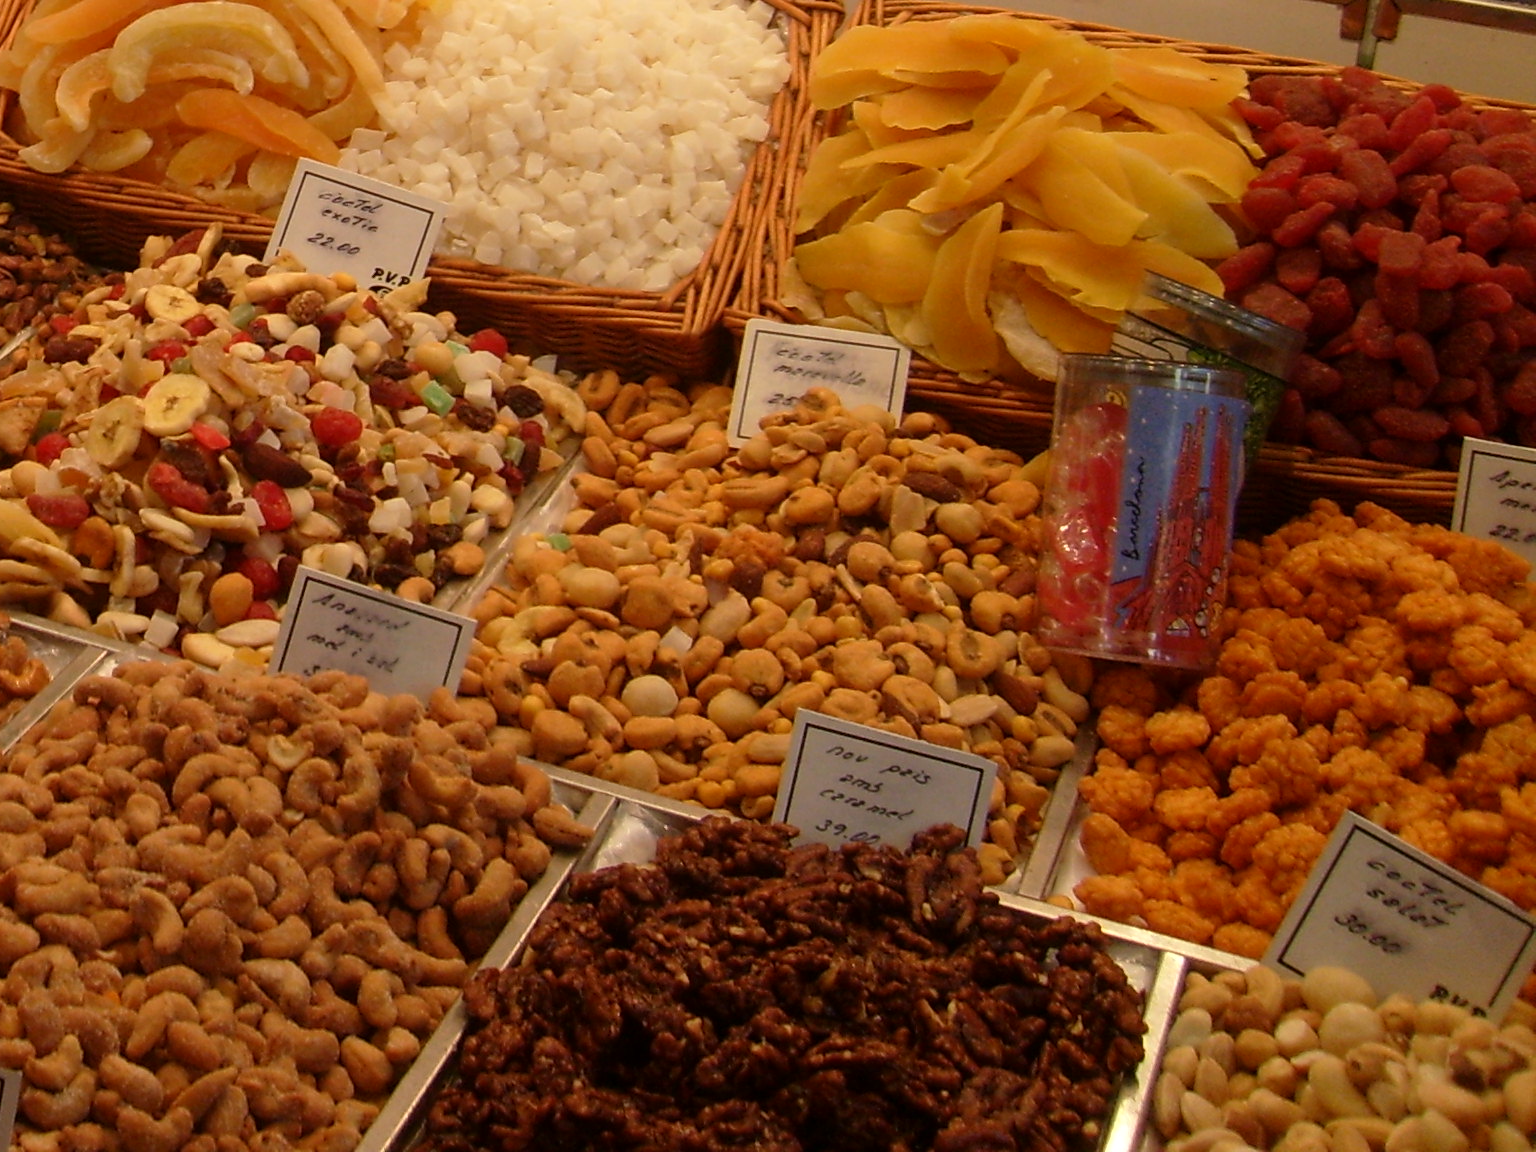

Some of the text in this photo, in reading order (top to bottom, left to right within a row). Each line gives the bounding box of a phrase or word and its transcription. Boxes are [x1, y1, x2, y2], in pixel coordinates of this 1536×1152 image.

[307, 232, 362, 255] 22.00
[815, 819, 881, 845] 39.00
[1333, 914, 1403, 954] 30.00
